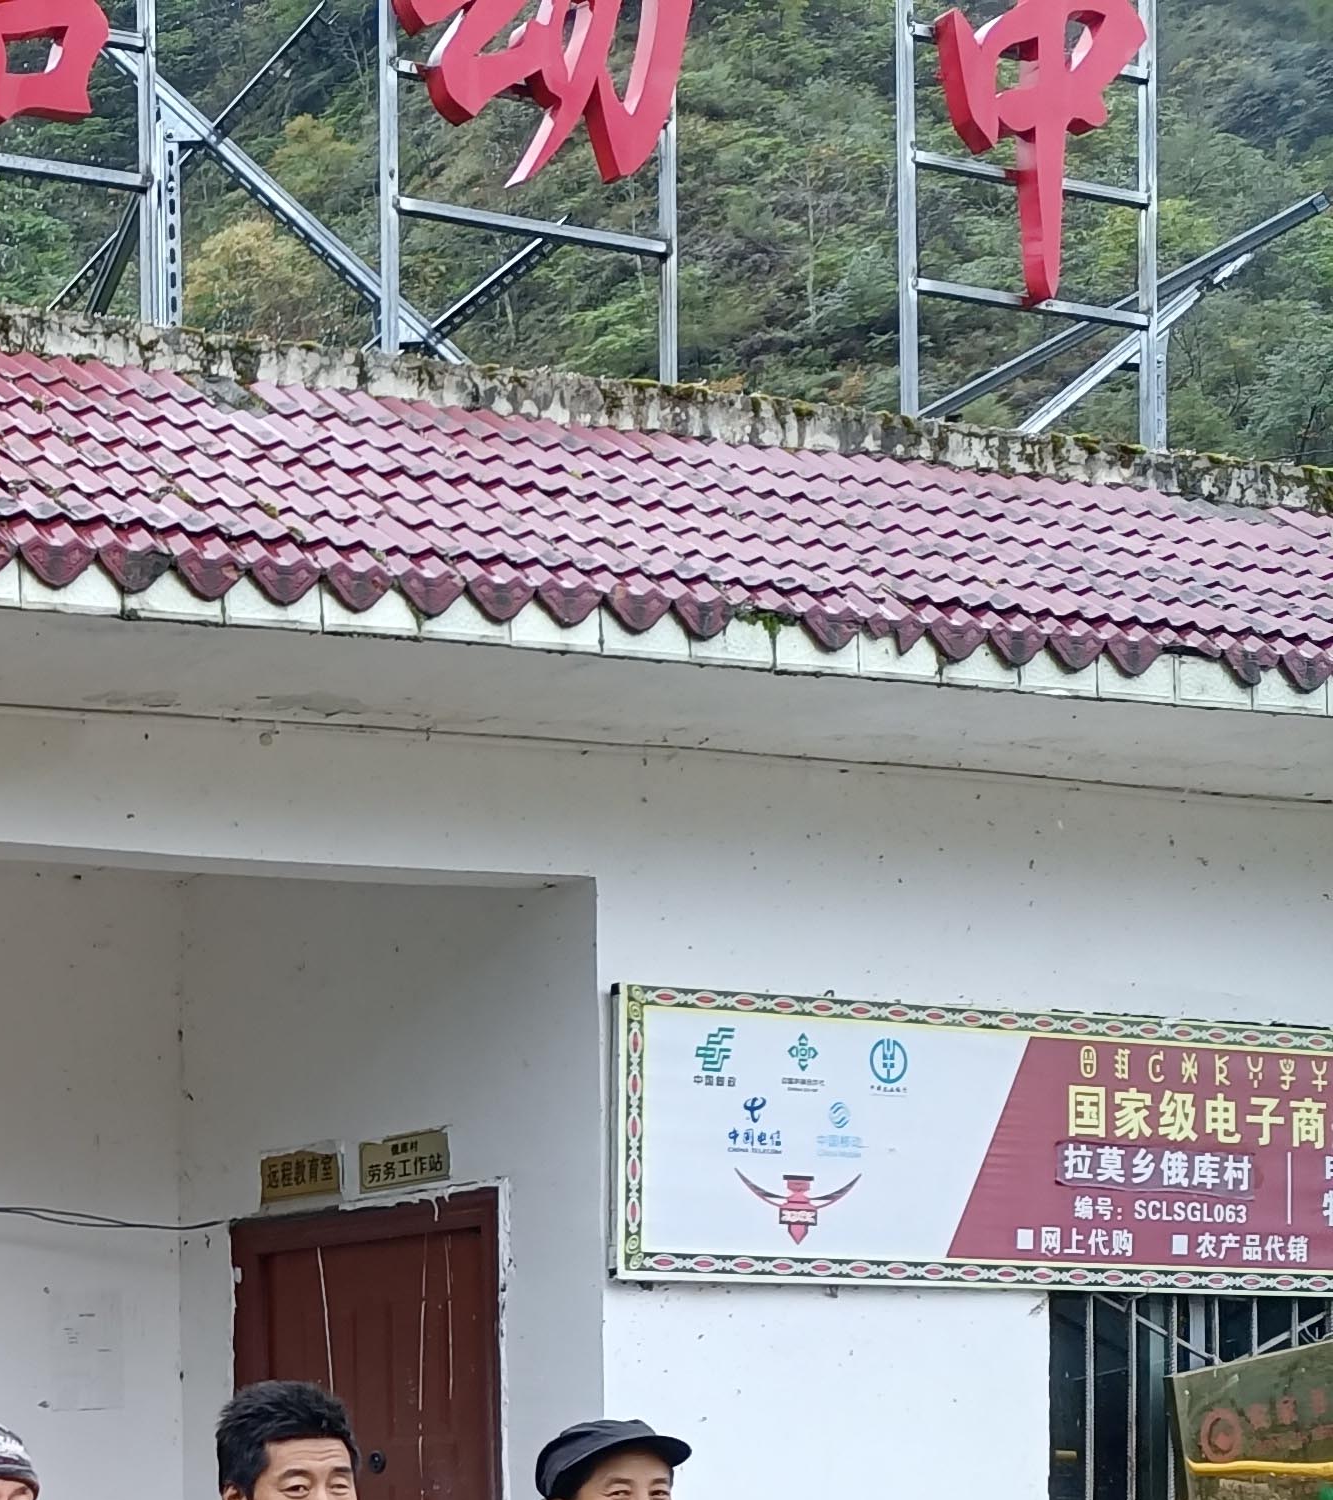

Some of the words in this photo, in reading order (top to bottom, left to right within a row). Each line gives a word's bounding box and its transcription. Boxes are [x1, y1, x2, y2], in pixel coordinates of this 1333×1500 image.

[1068, 1084, 1333, 1150] 国家级电子商
[266, 1154, 334, 1189] 远程教育室
[368, 1152, 443, 1184] 劳务工作站
[1064, 1144, 1252, 1192] 拉莫乡俄库村
[1041, 1226, 1134, 1256] 网上代购
[1196, 1232, 1310, 1263] 农产品代销
